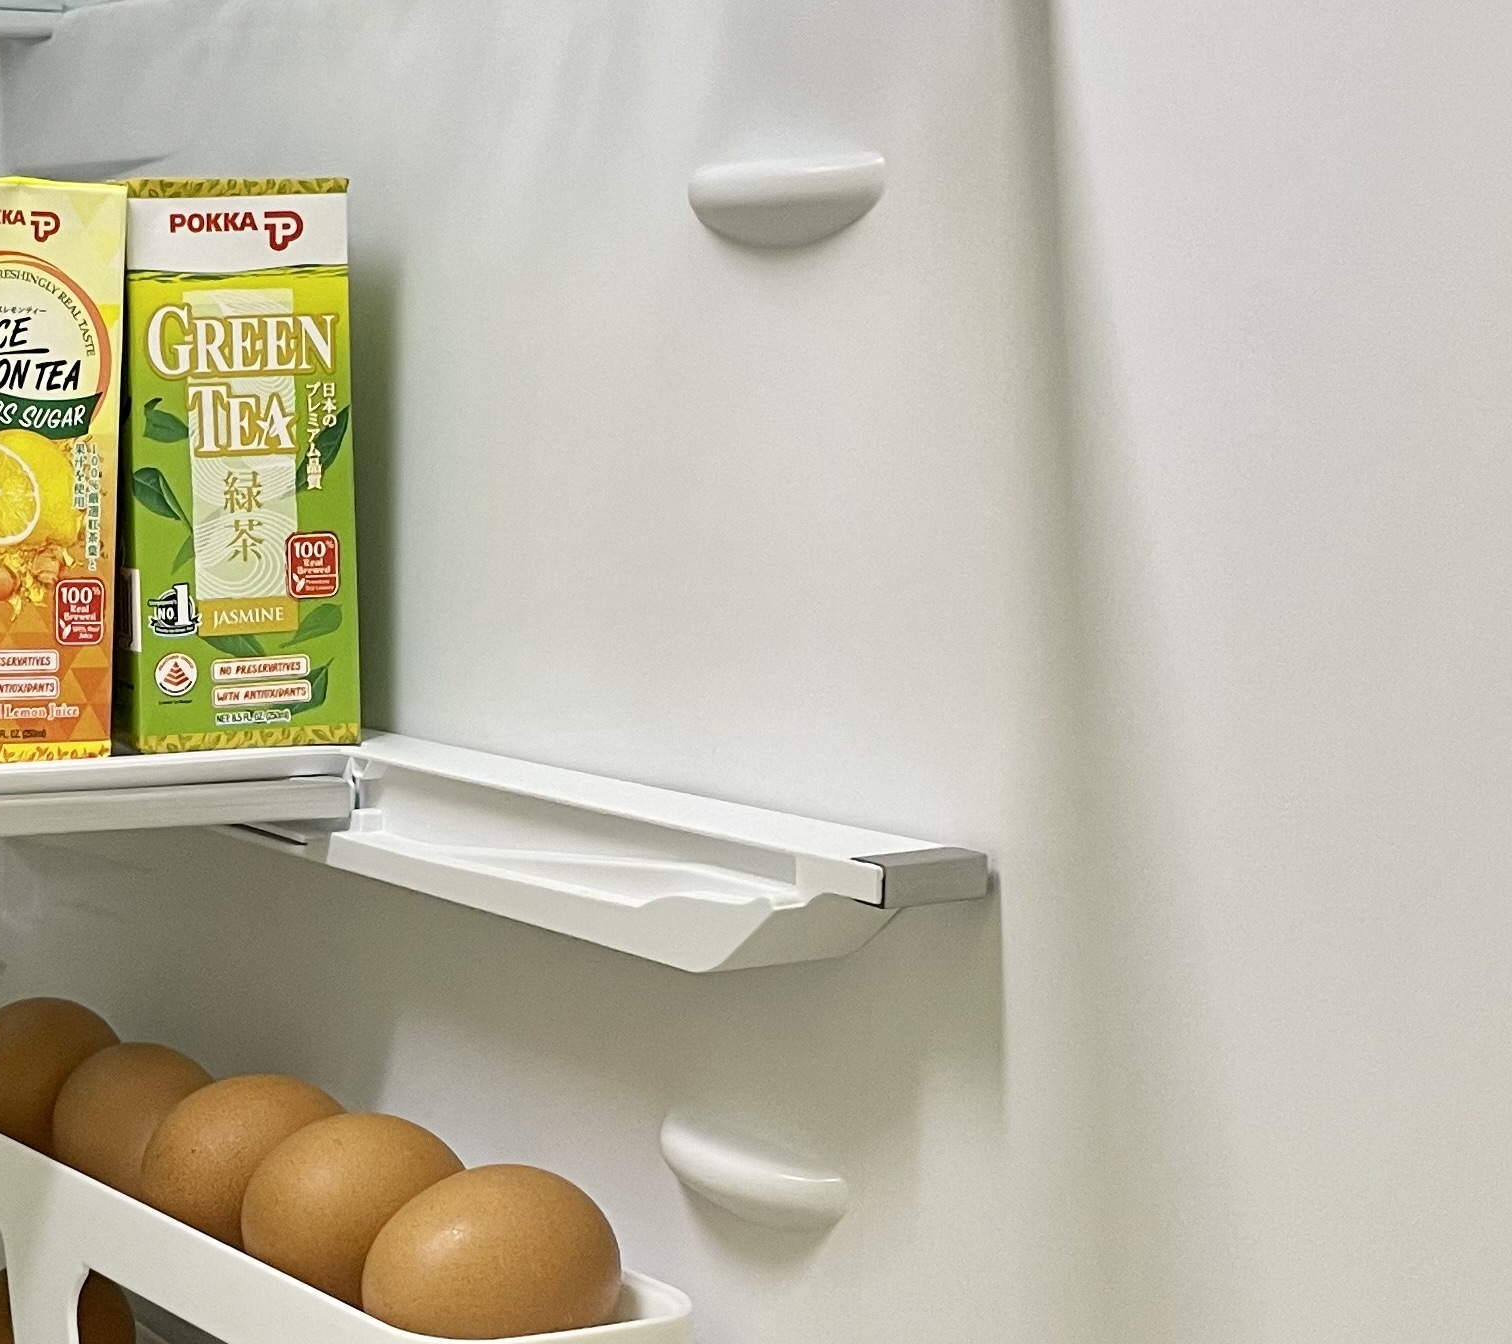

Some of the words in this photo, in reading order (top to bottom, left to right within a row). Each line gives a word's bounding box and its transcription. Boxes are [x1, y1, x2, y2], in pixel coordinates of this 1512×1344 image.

[170, 212, 258, 233] POKKA
[57, 291, 80, 321] REAL
[78, 321, 96, 357] TASTE
[147, 305, 336, 375] GREEN
[35, 359, 81, 391] TEA
[18, 405, 86, 429] SUGAR
[322, 382, 337, 428] 日本の
[188, 385, 296, 452] TEA
[213, 607, 284, 630] JASMINE
[219, 664, 232, 676] NO
[235, 661, 302, 675] PRESERVATIVES
[216, 690, 240, 702] WITH
[243, 686, 307, 701] ANTIOXIDANTS
[4, 704, 46, 720] Lemon
[48, 703, 80, 720] Juice
